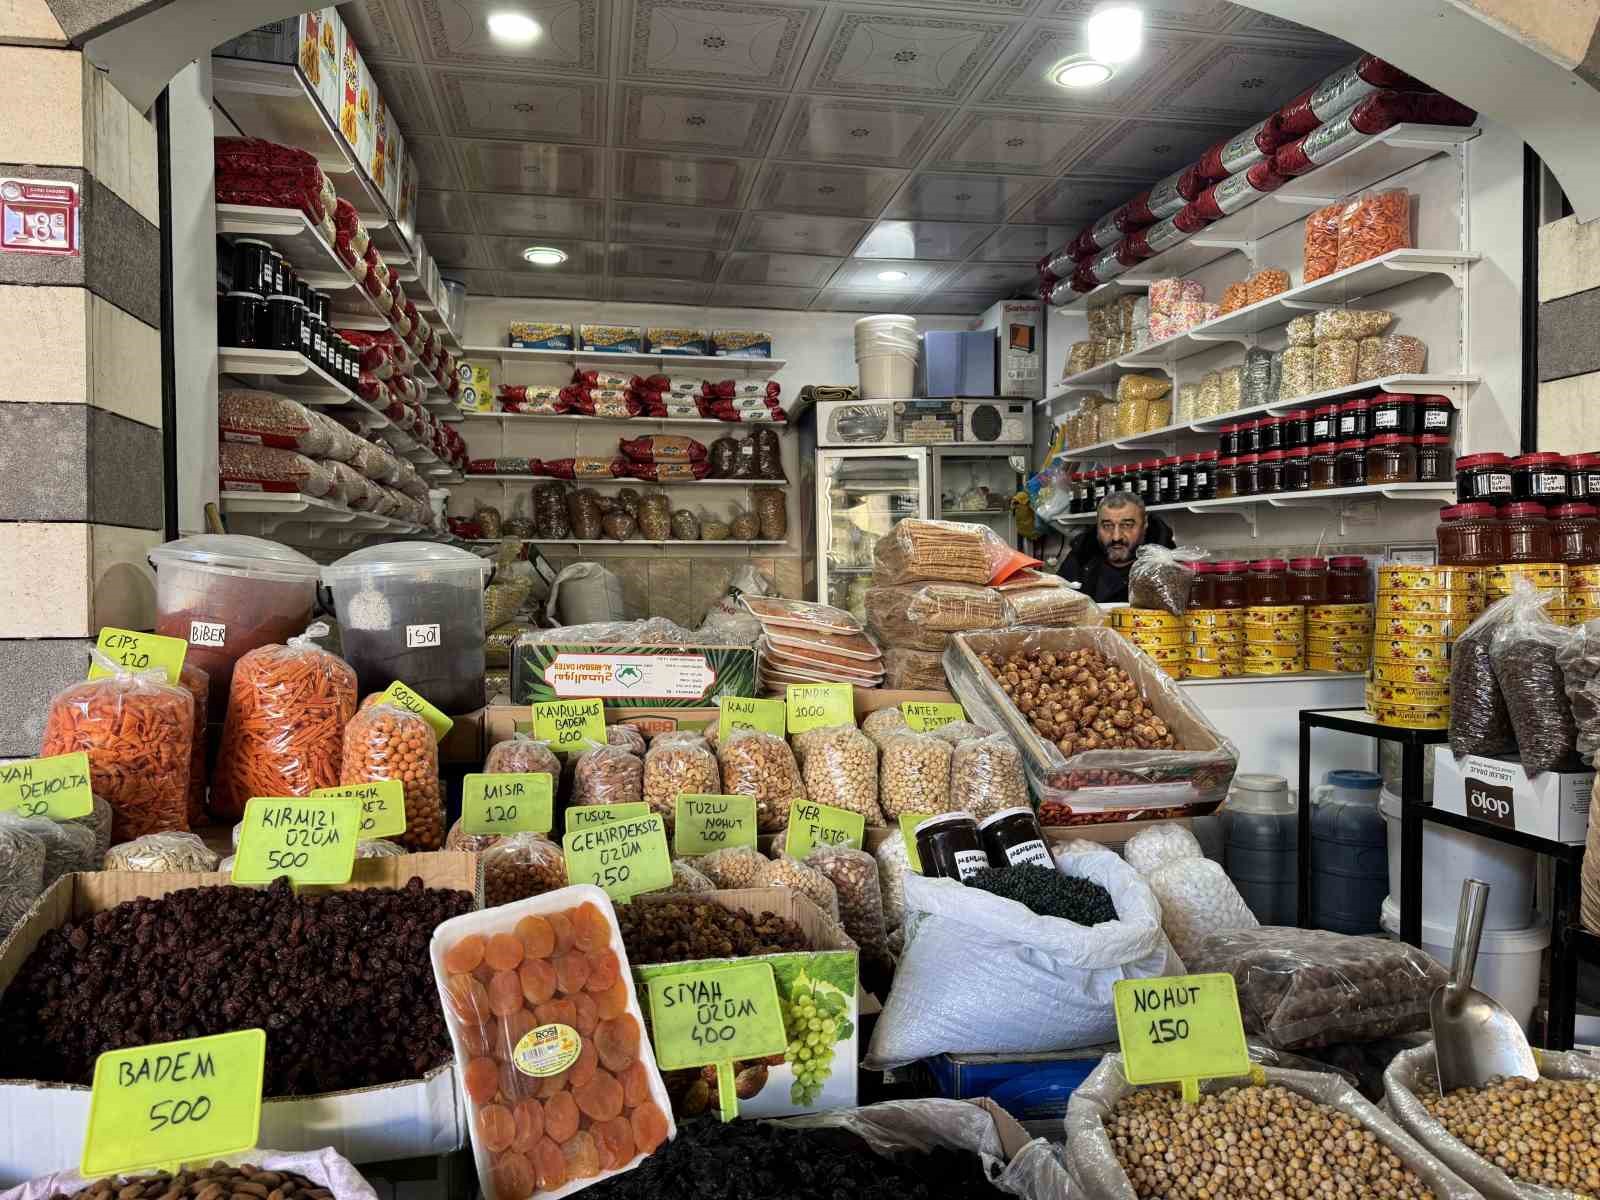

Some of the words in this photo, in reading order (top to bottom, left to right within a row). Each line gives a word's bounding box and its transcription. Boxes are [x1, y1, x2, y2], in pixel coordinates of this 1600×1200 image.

[120, 652, 149, 668] 120
[391, 687, 425, 713] SOSLU
[727, 700, 755, 713] KAJU
[794, 705, 825, 718] 1000
[906, 704, 938, 716] ANTEP
[555, 715, 588, 730] BADEM
[559, 729, 582, 744] 600
[0, 765, 33, 784] YAH
[484, 783, 525, 800] MISIR
[686, 800, 728, 817] TUZLU
[796, 804, 821, 822] YER
[1471, 791, 1509, 818] dojo
[262, 807, 335, 828] KIRMIZI
[485, 805, 517, 823] 120
[705, 817, 744, 830] NOHUT
[266, 850, 309, 870] 500
[591, 865, 630, 888] 250
[663, 980, 722, 1008] SİYAH
[1133, 986, 1201, 1013] NOHUT
[1148, 1018, 1189, 1044] 150
[119, 1051, 216, 1087] BADEM
[149, 1095, 212, 1132] 500
